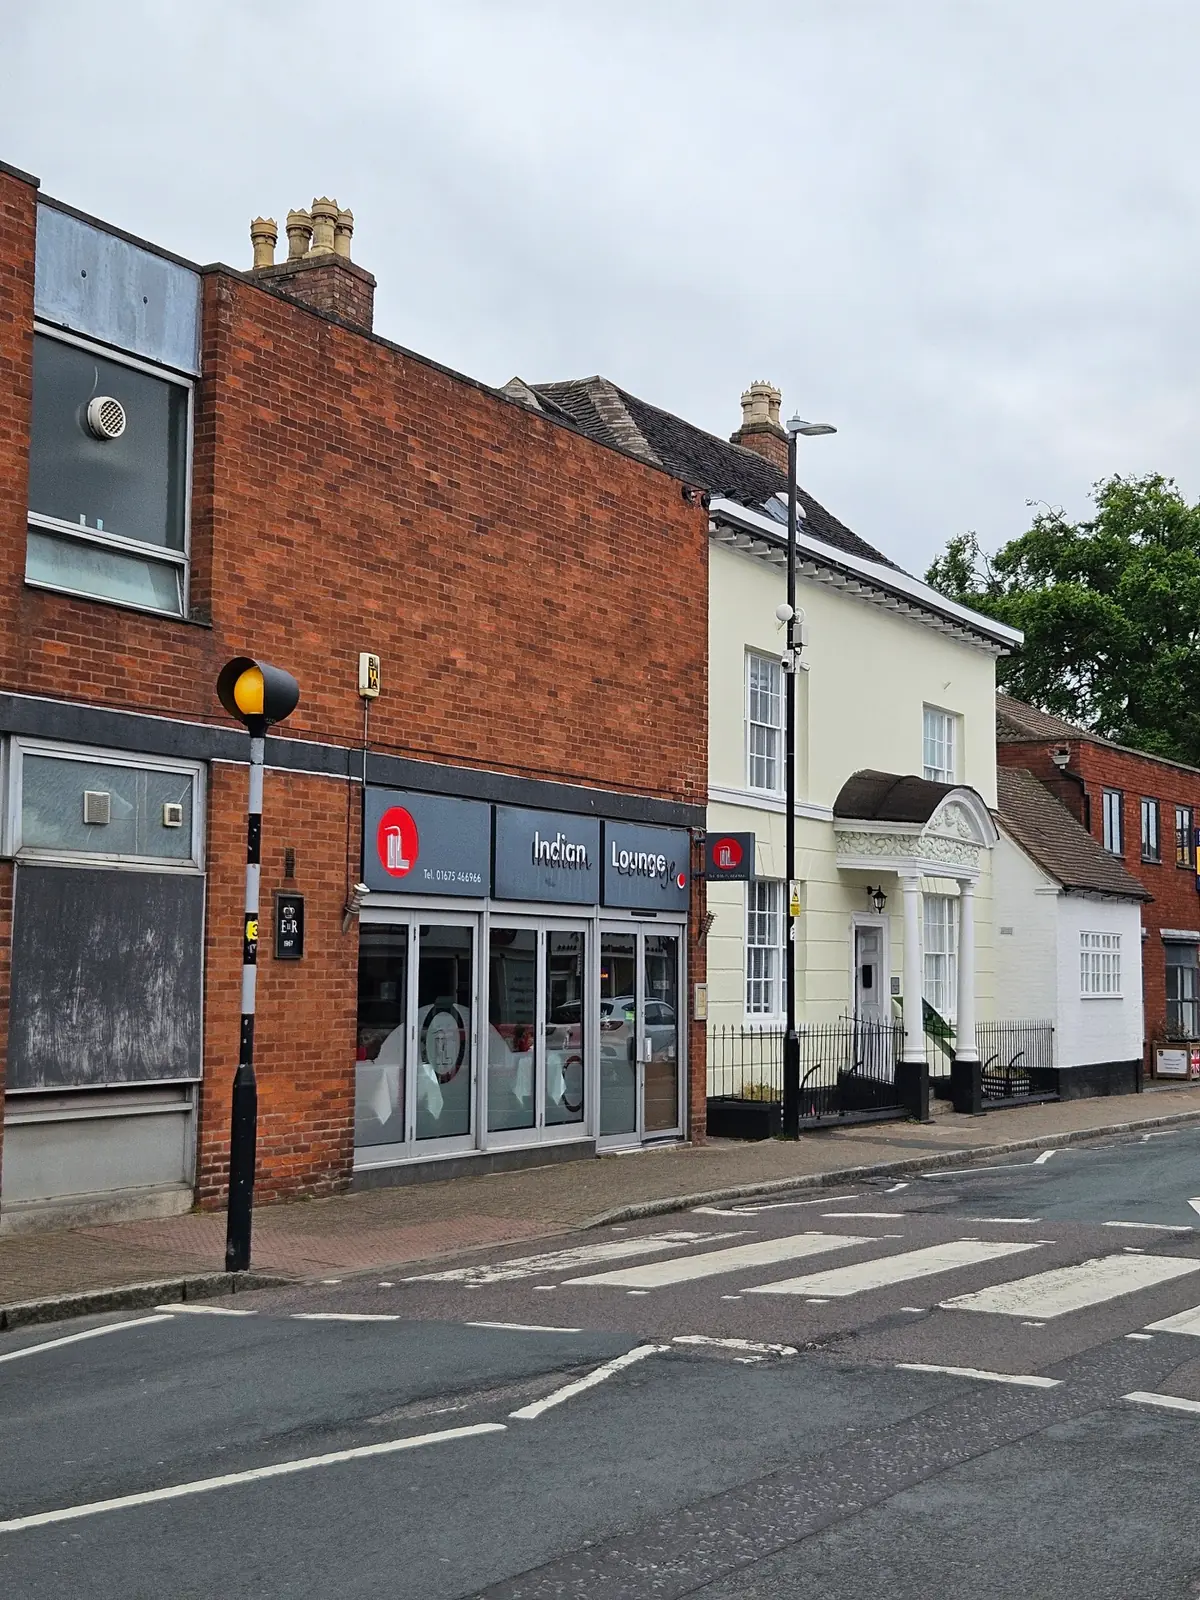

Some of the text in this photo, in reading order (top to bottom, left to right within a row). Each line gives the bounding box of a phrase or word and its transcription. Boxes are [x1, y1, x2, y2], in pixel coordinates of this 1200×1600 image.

[534, 831, 666, 878] Indian Lounge
[423, 869, 482, 883] Tel. 01675 466966
